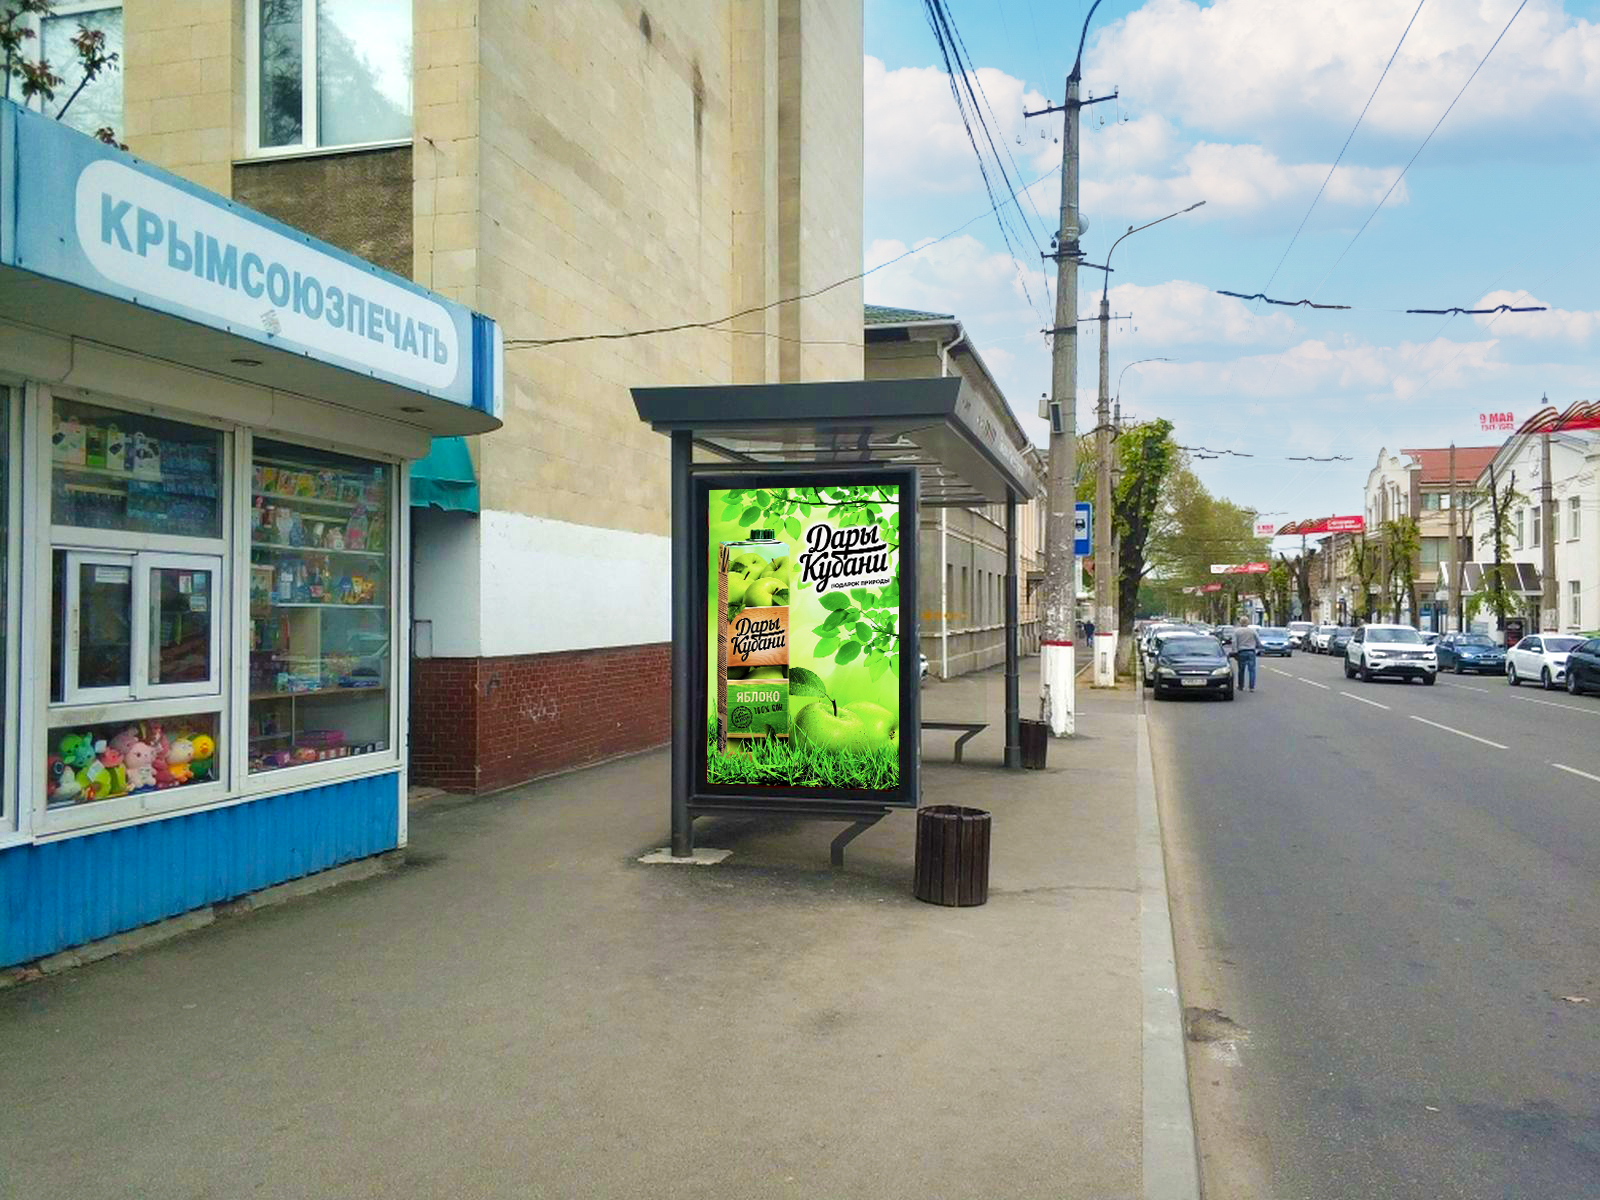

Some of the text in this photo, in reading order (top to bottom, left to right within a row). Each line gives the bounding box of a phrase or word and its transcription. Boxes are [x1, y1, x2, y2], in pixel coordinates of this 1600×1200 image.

[100, 192, 448, 365] КРЫМСОЮЗПЕЧАТЬ
[1480, 412, 1514, 423] 9 МАЯ
[806, 523, 881, 555] Дары
[799, 549, 889, 593] Кубани
[831, 578, 890, 589] ПОДАРОК ПРИРОДЫ
[735, 617, 782, 638] Дары
[731, 635, 786, 662] Кубани
[736, 691, 780, 703] ЯБЛОКО
